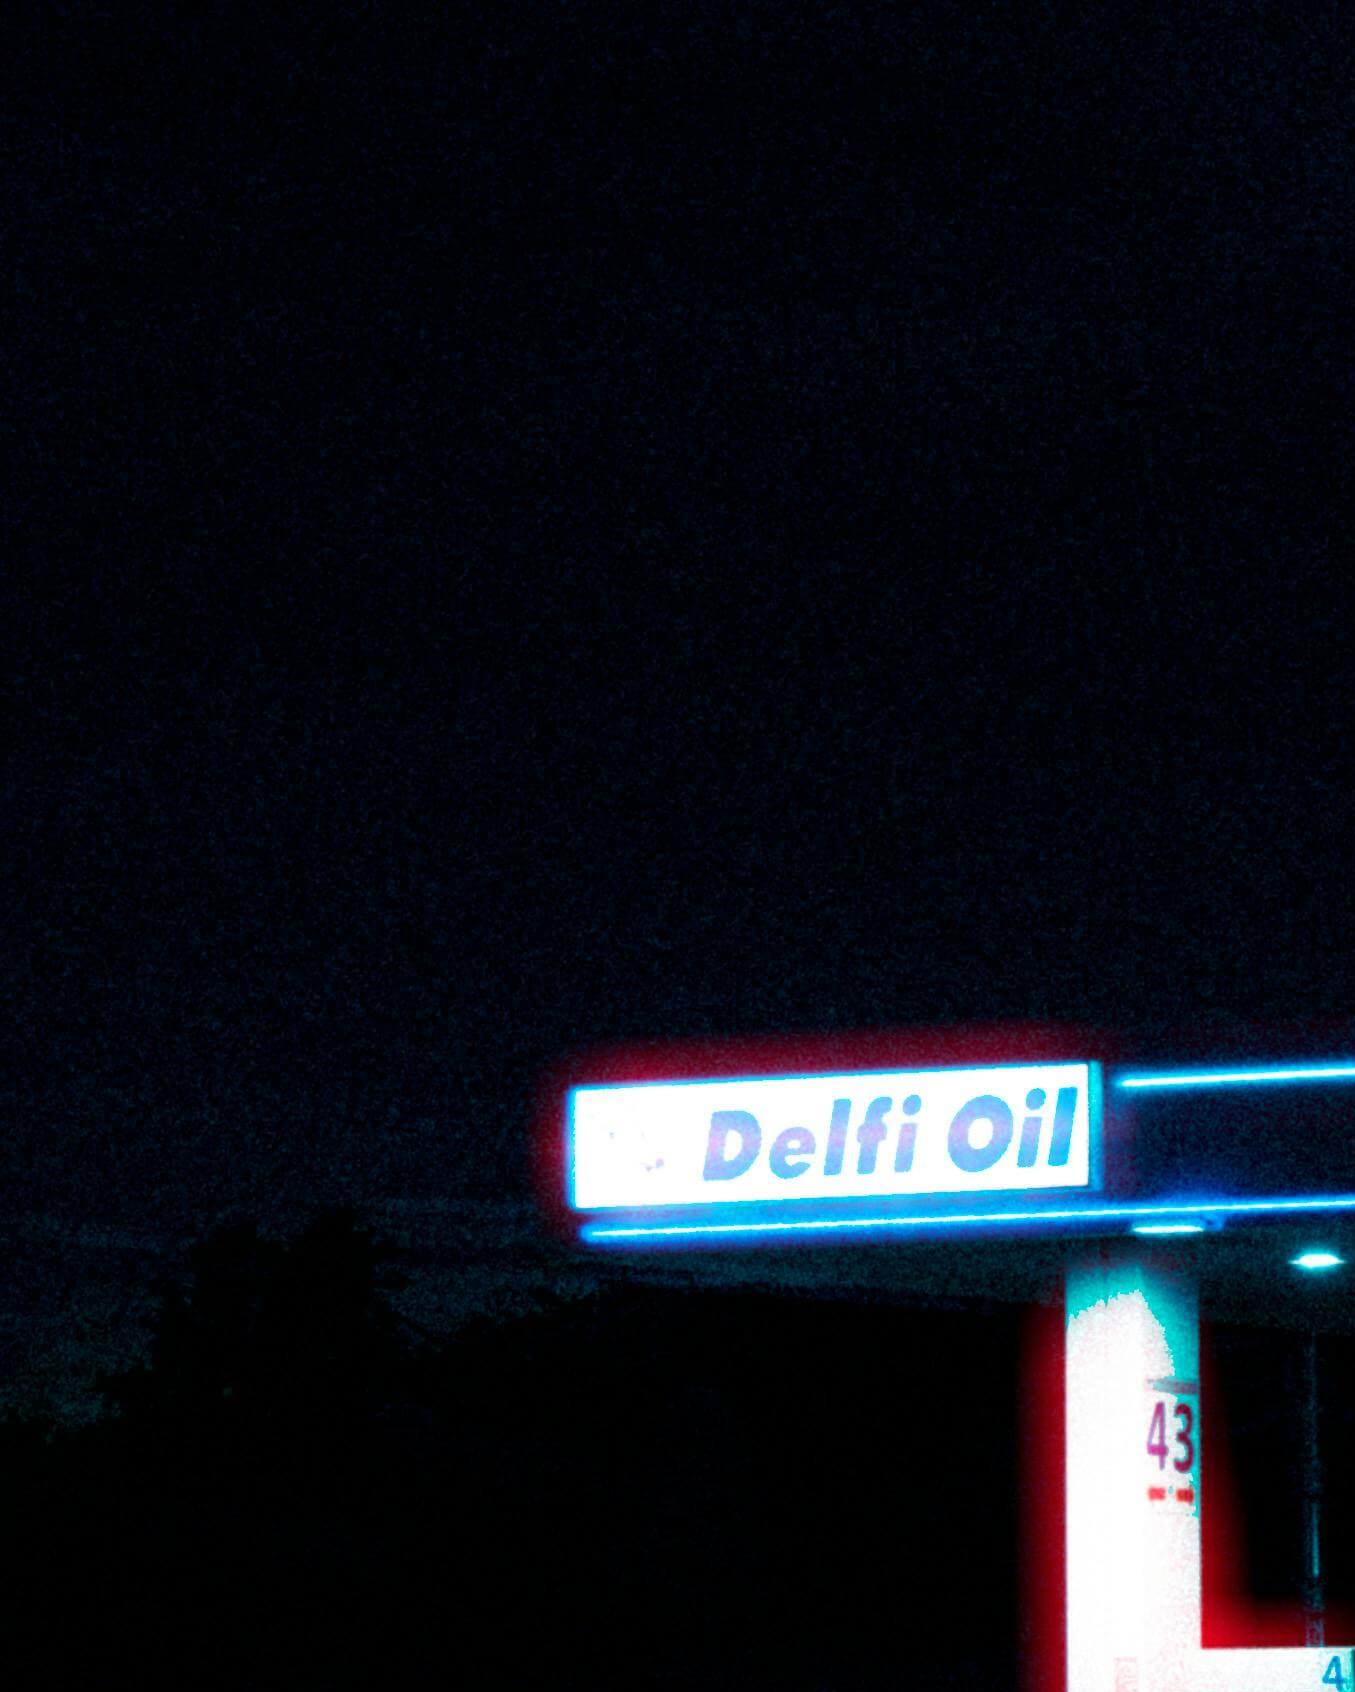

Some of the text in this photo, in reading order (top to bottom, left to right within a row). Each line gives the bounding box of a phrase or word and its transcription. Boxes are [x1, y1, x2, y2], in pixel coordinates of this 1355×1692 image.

[702, 1087, 1078, 1181] Delfi Oil
[1147, 1401, 1194, 1473] 43
[1322, 1656, 1346, 1692] 4
